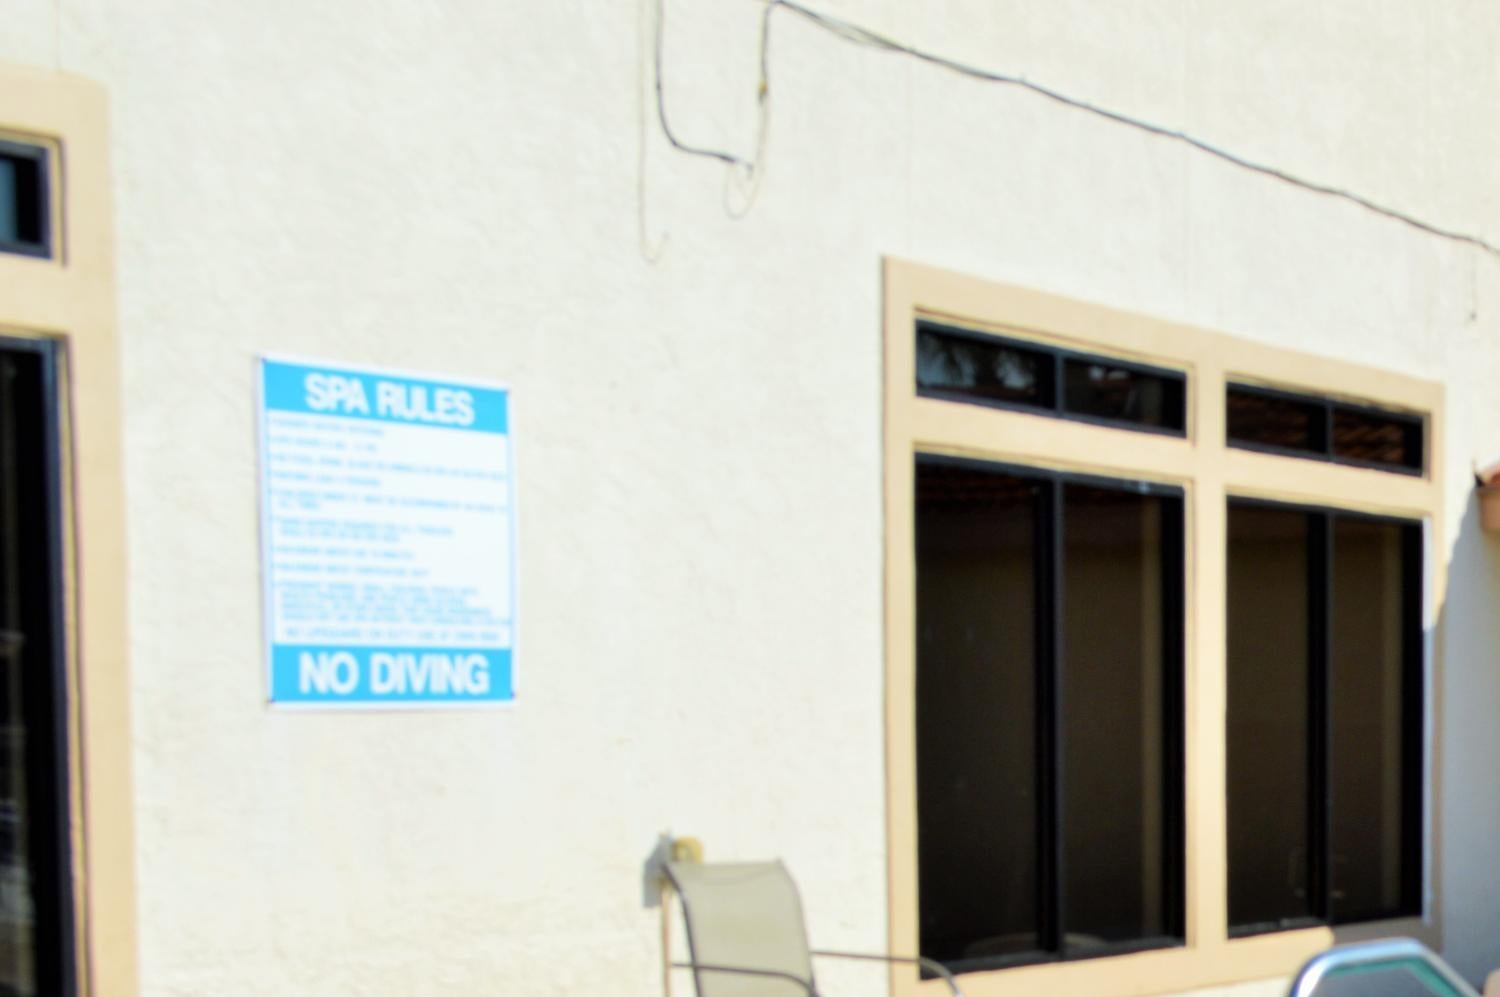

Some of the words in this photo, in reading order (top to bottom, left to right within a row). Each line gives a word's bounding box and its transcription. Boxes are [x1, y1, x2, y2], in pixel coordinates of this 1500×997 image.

[304, 372, 369, 415] SPA
[374, 381, 475, 426] RULES
[299, 652, 360, 695] NO
[369, 653, 490, 695] DIVING
